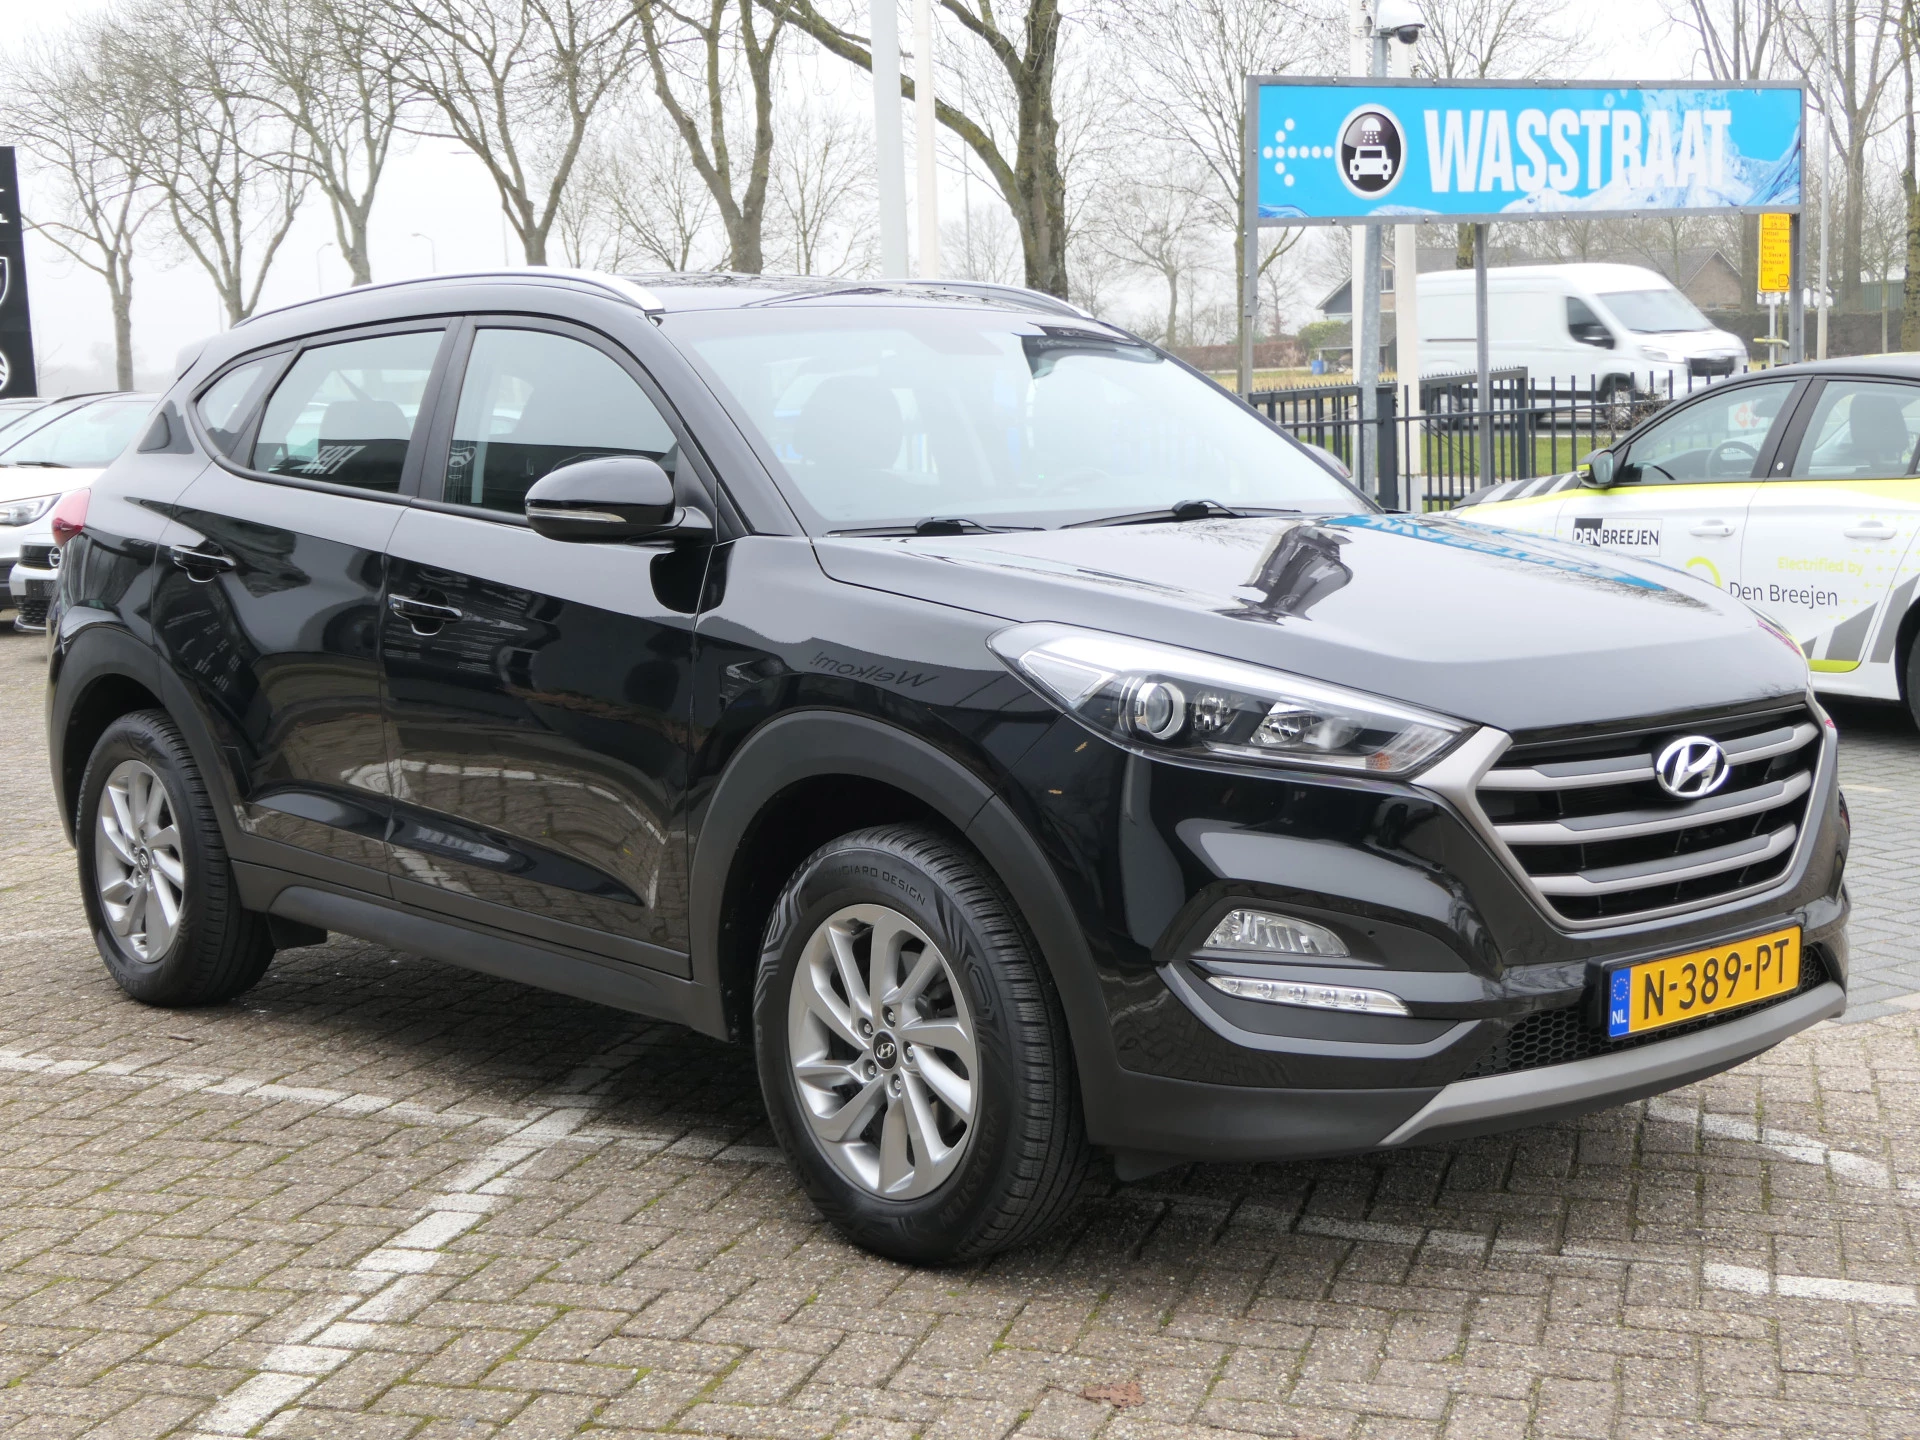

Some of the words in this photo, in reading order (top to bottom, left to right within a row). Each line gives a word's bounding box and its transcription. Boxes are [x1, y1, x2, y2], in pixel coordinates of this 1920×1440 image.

[1424, 108, 1731, 192] WASSTRAAT
[1602, 529, 1660, 546] BREEJEN
[1777, 556, 1844, 573] Electrified
[1847, 561, 1864, 577] by
[1729, 582, 1763, 601] Den
[1769, 584, 1838, 609] Breejen
[882, 871, 926, 906] DESIGN
[1643, 938, 1790, 1020] N-389-PT
[1611, 1010, 1627, 1025] NL
